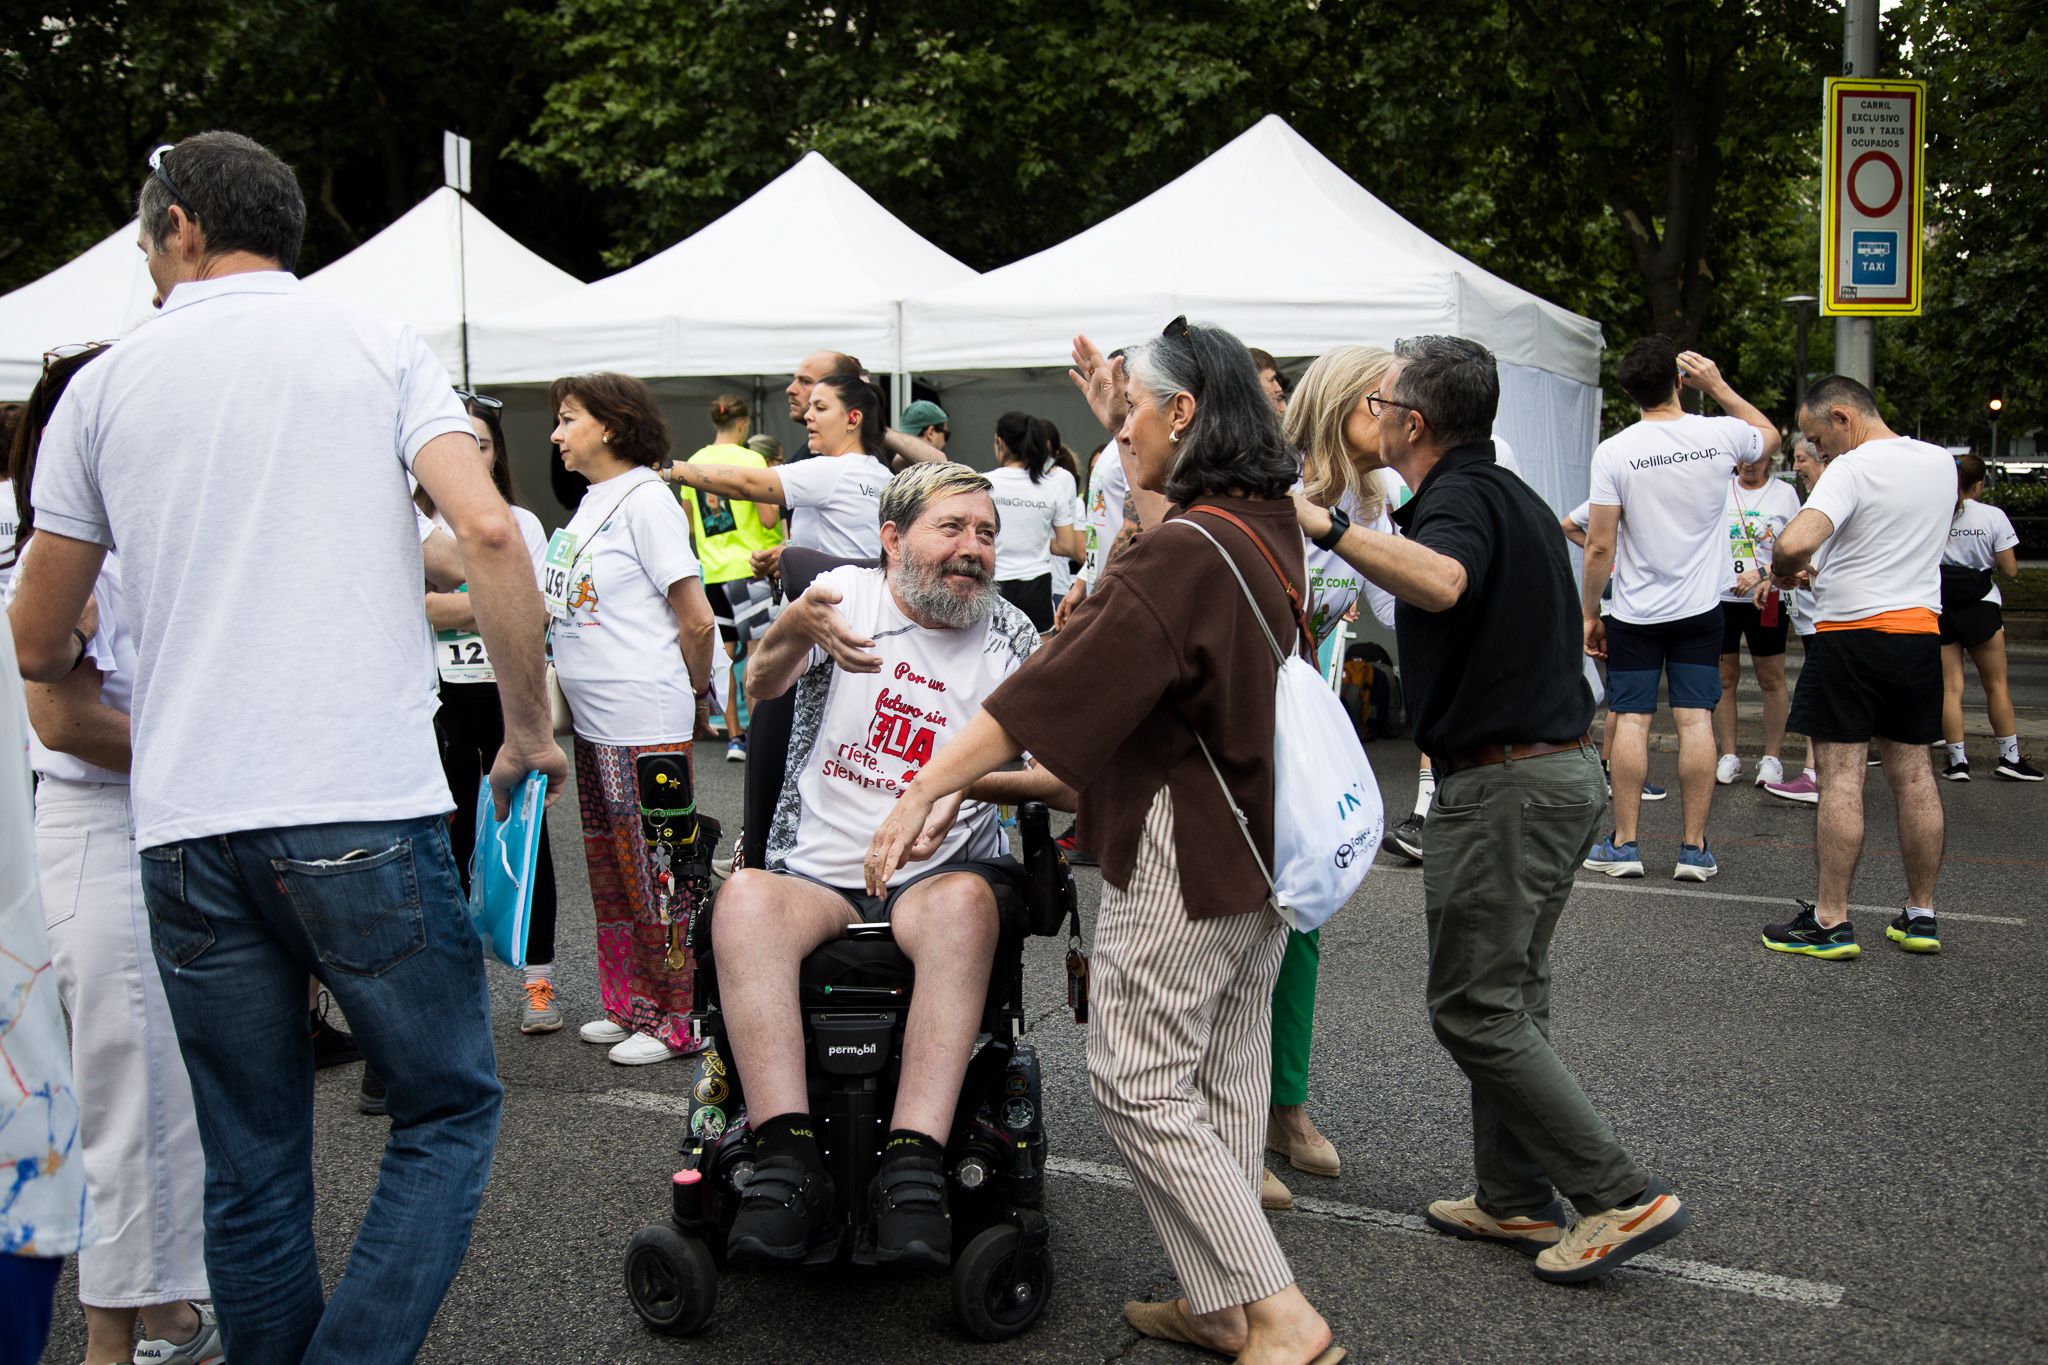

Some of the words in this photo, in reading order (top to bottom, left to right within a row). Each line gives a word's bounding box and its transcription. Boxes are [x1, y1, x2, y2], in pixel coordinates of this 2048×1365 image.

[1861, 101, 1891, 110] CARRIL
[1852, 113, 1900, 123] EXCLUSIVO
[1846, 126, 1865, 135] BUS
[1870, 127, 1875, 135] Y
[1880, 127, 1905, 136] TAXIS
[1851, 139, 1900, 148] OCUPADOS
[1862, 262, 1885, 271] TAXI
[1629, 446, 1721, 470] VelillaGroup.
[1734, 560, 1745, 574] 8
[894, 662, 926, 684] Por
[928, 678, 946, 692] un
[875, 688, 923, 718] futuro
[924, 710, 947, 727] sin
[865, 710, 936, 768] ELA
[828, 1043, 876, 1057] permobil
